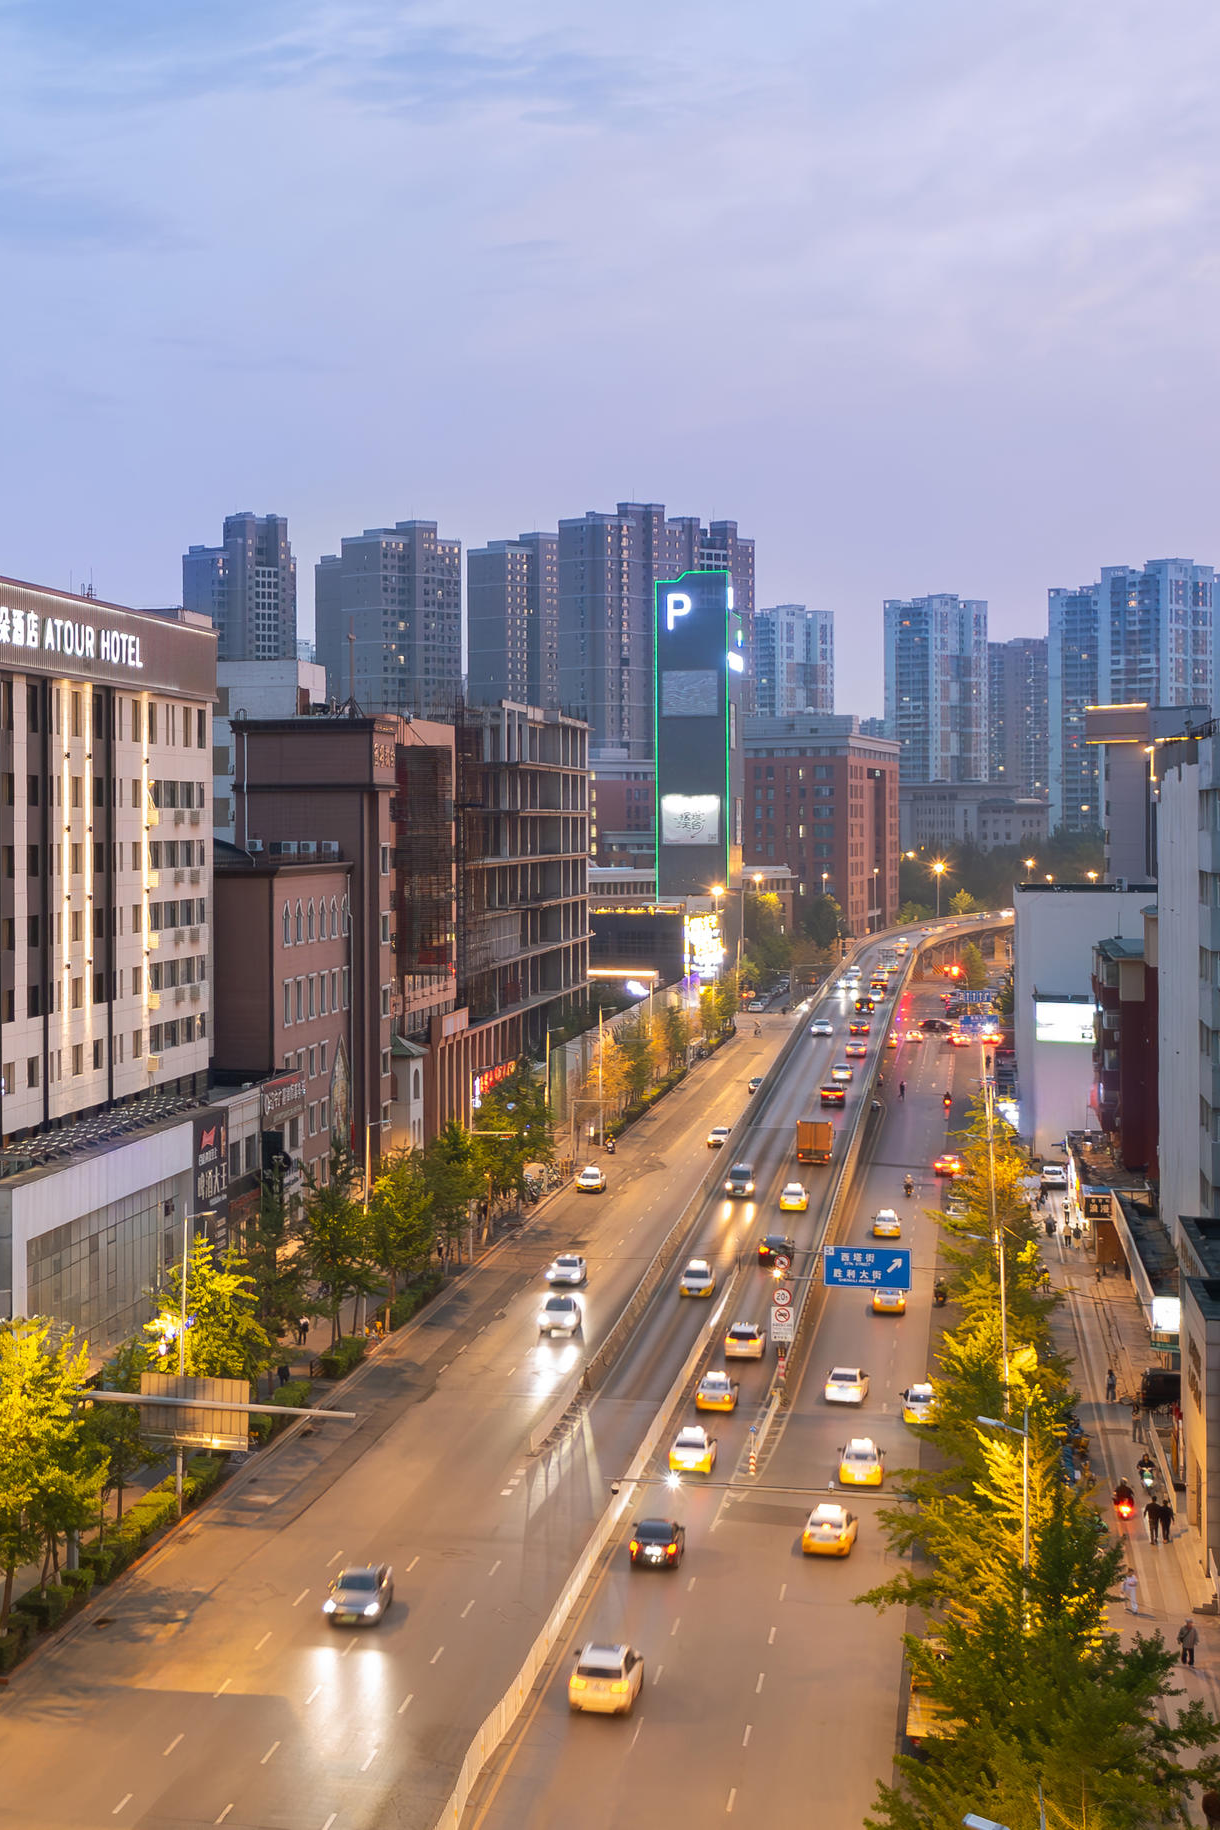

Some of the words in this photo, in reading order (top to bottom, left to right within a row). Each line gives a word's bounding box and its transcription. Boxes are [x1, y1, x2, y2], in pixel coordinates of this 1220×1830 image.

[666, 593, 692, 631] P
[44, 617, 95, 658] ATOUR
[100, 629, 144, 668] HOTEL
[197, 1161, 228, 1201] 啤酒大王
[833, 1268, 882, 1280] 胜利大街
[840, 1252, 875, 1263] 西塔街
